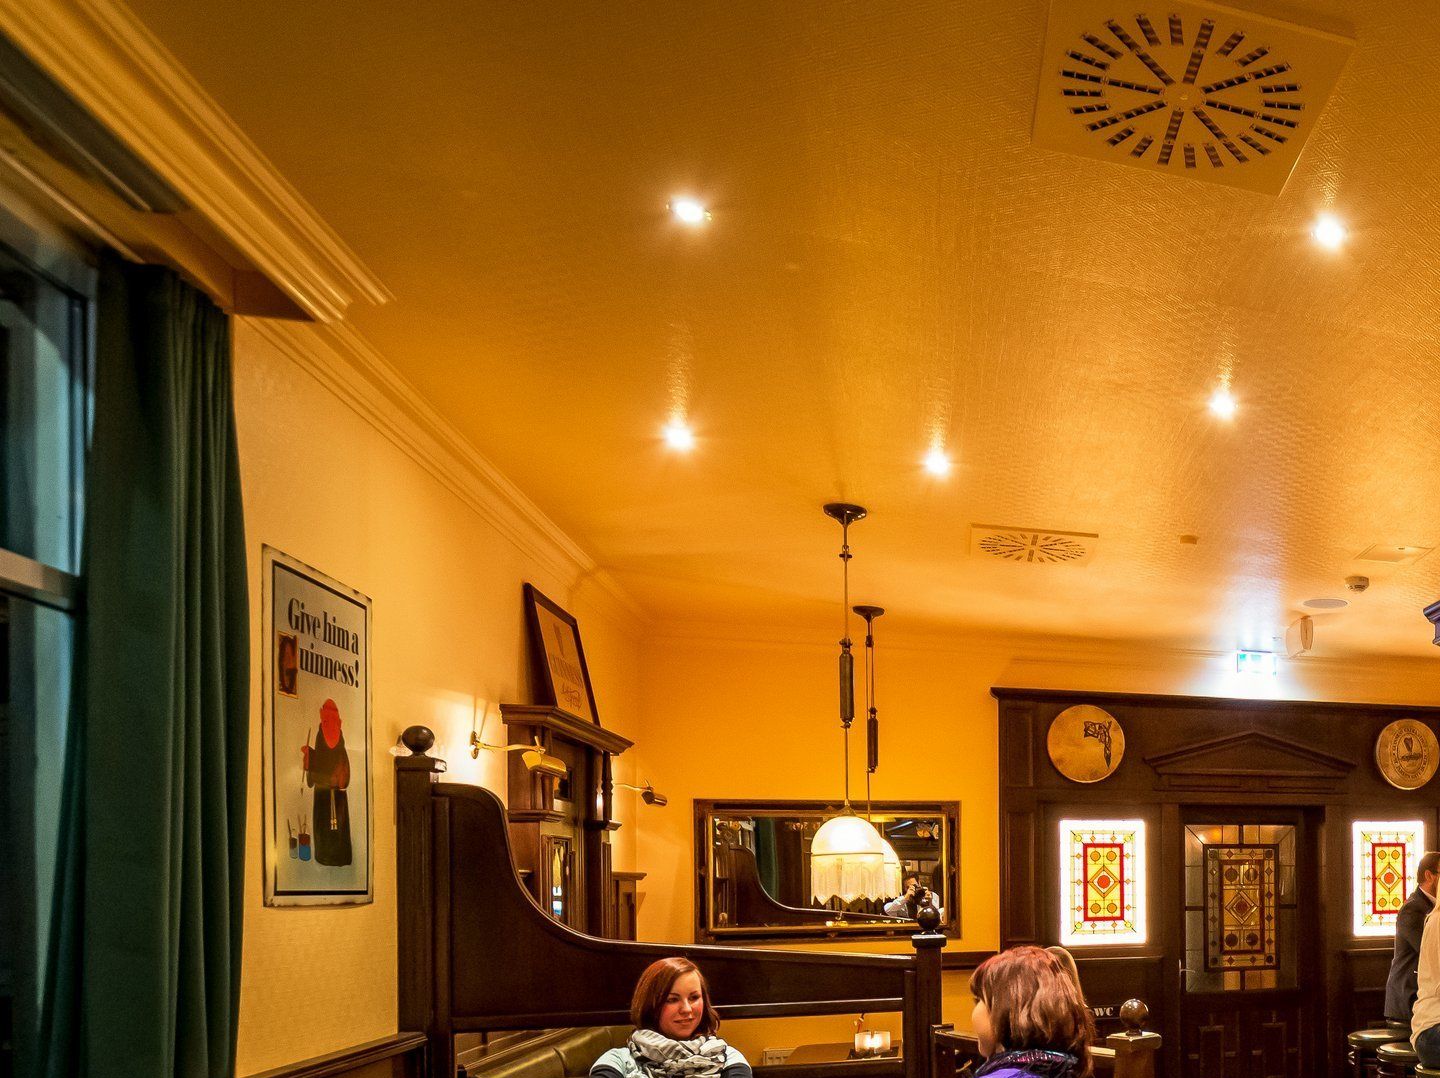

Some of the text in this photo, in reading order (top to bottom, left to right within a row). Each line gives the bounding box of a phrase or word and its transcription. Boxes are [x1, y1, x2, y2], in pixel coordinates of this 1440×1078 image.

[288, 597, 359, 655] Give him a
[1093, 1006, 1114, 1017] WC
